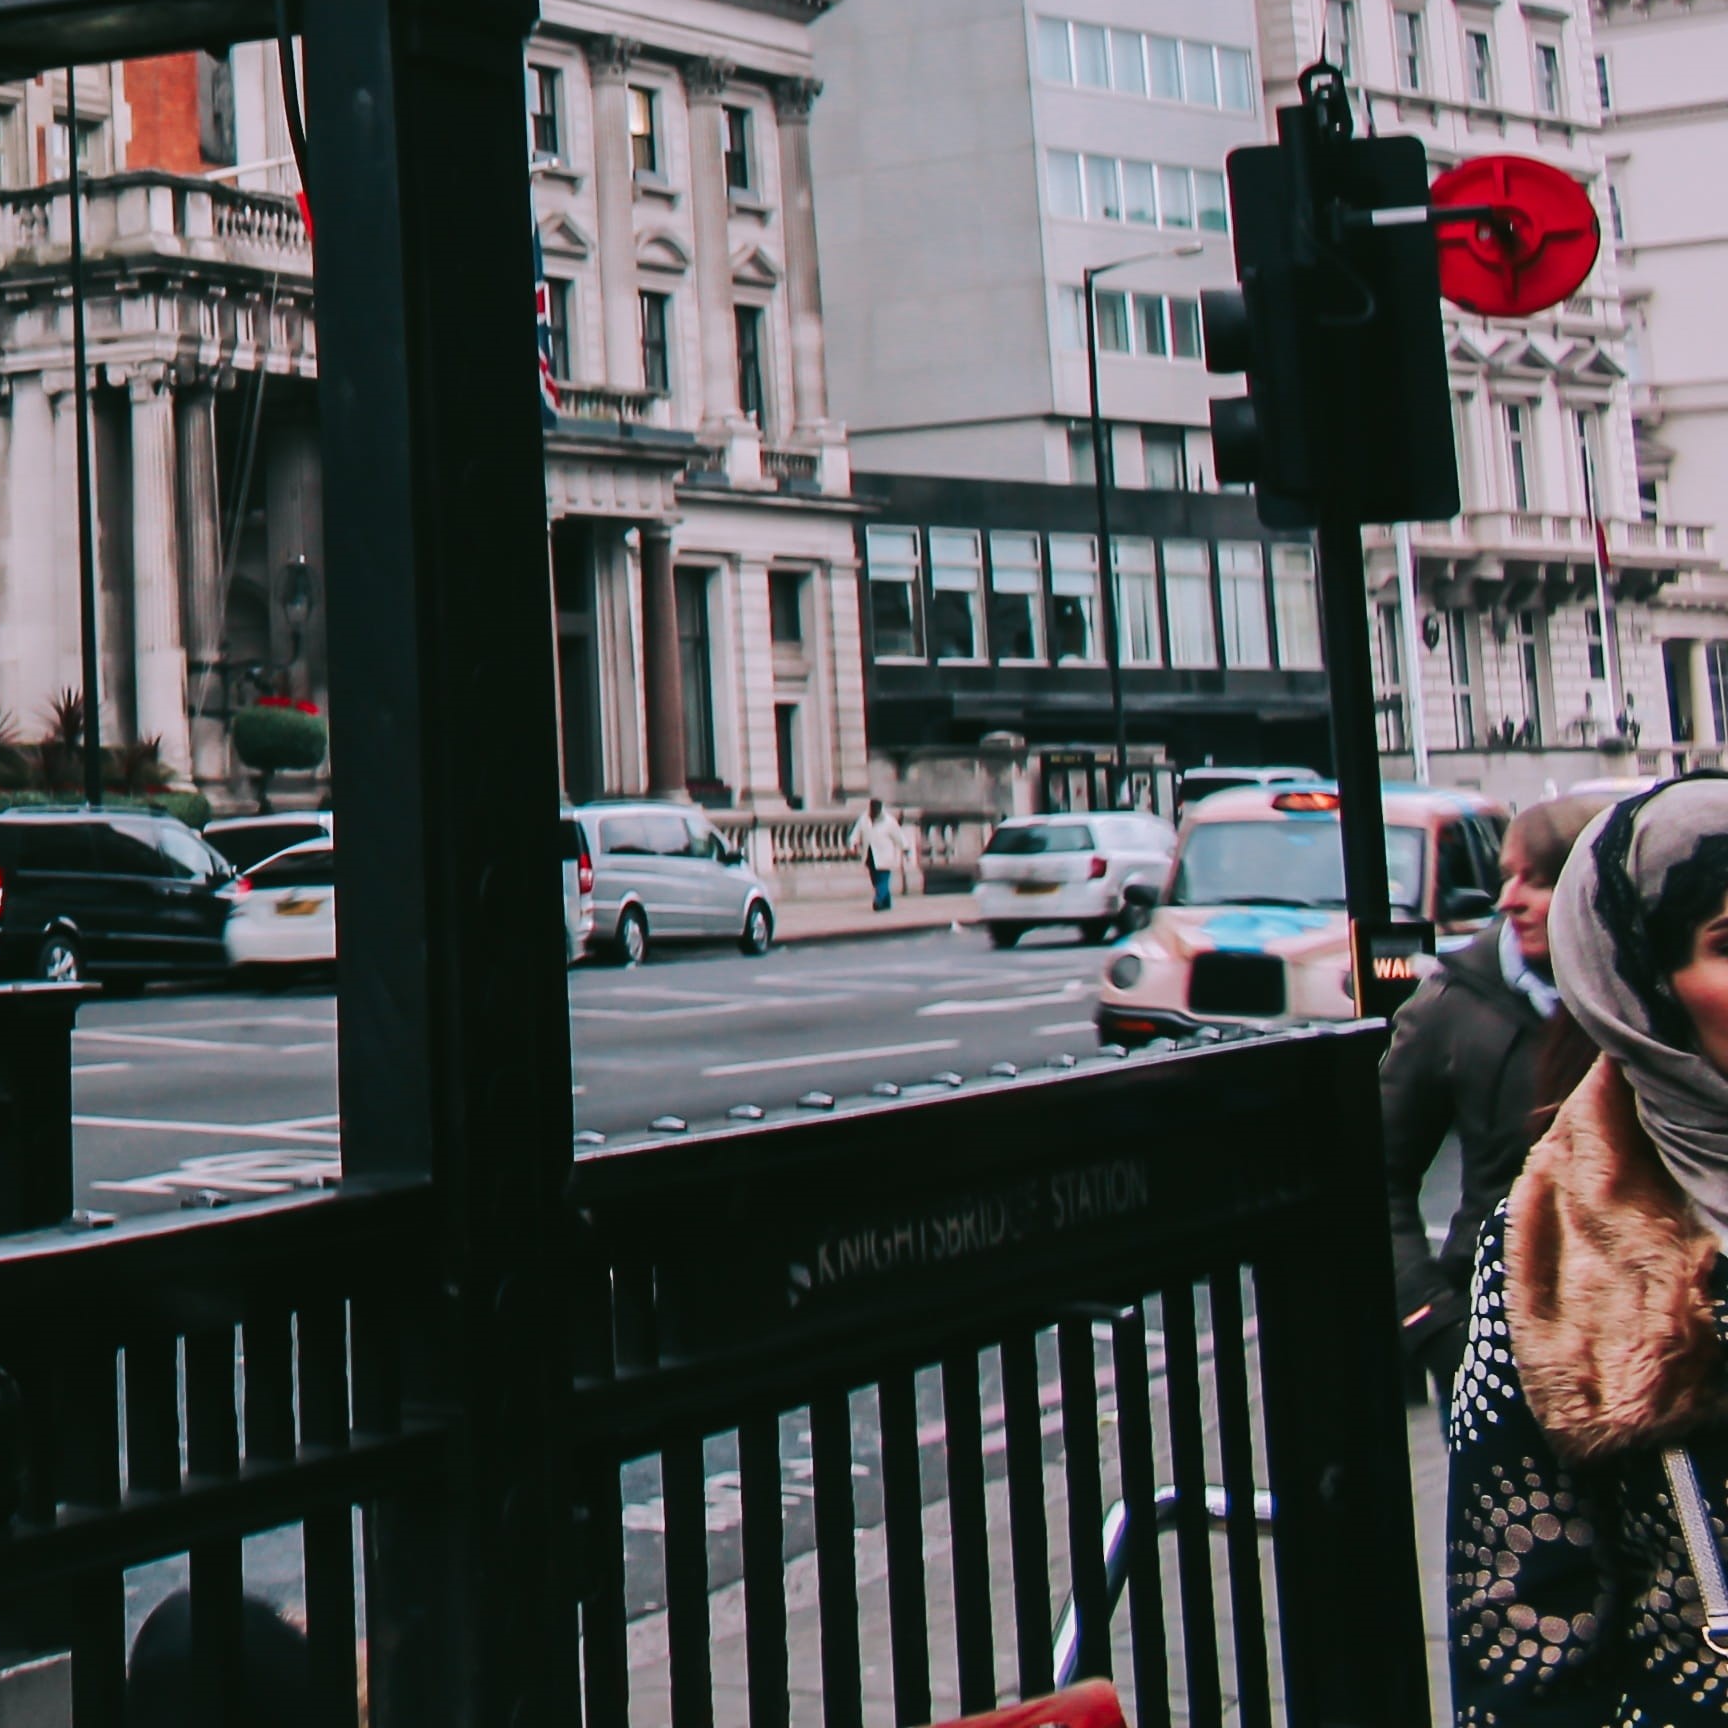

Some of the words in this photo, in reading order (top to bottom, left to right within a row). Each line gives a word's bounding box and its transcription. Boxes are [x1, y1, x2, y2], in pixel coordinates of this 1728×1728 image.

[1373, 957, 1412, 979] WAI
[817, 1181, 1040, 1284] KNIGHTSBRID
[1050, 1158, 1149, 1229] STATION
